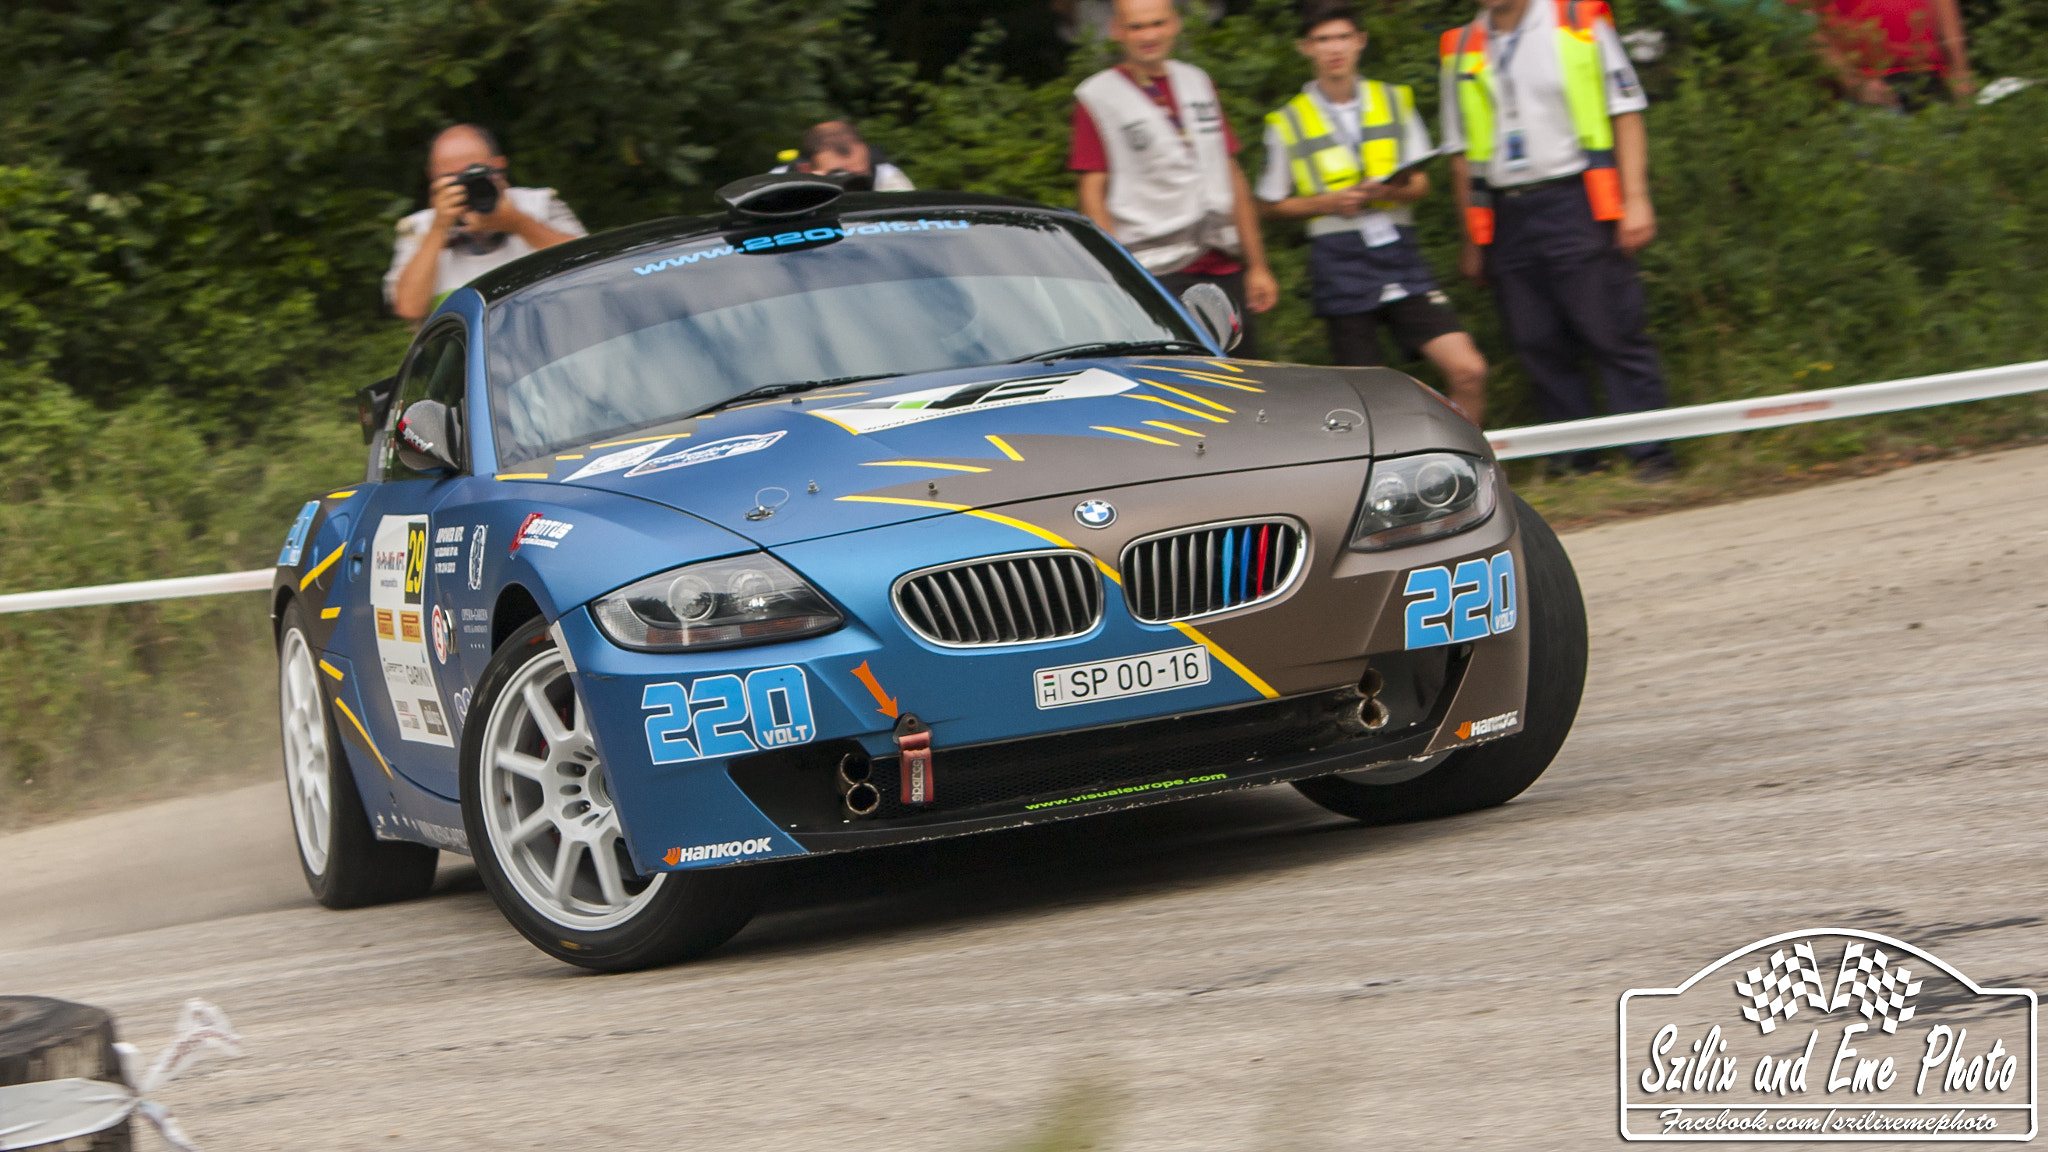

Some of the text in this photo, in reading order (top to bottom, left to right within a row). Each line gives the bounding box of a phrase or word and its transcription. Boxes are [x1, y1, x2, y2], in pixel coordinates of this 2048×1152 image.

[633, 218, 970, 276] www.220volt.hu
[405, 530, 425, 594] 29
[1403, 550, 1517, 650] 220
[1495, 611, 1515, 630] VOLT
[1043, 688, 1057, 702] H
[1070, 652, 1200, 698] SP 00-16
[641, 664, 816, 765] 220
[763, 724, 808, 746] VOLT
[911, 759, 924, 802] sparco
[1025, 771, 1228, 811] www.visualeurope.com
